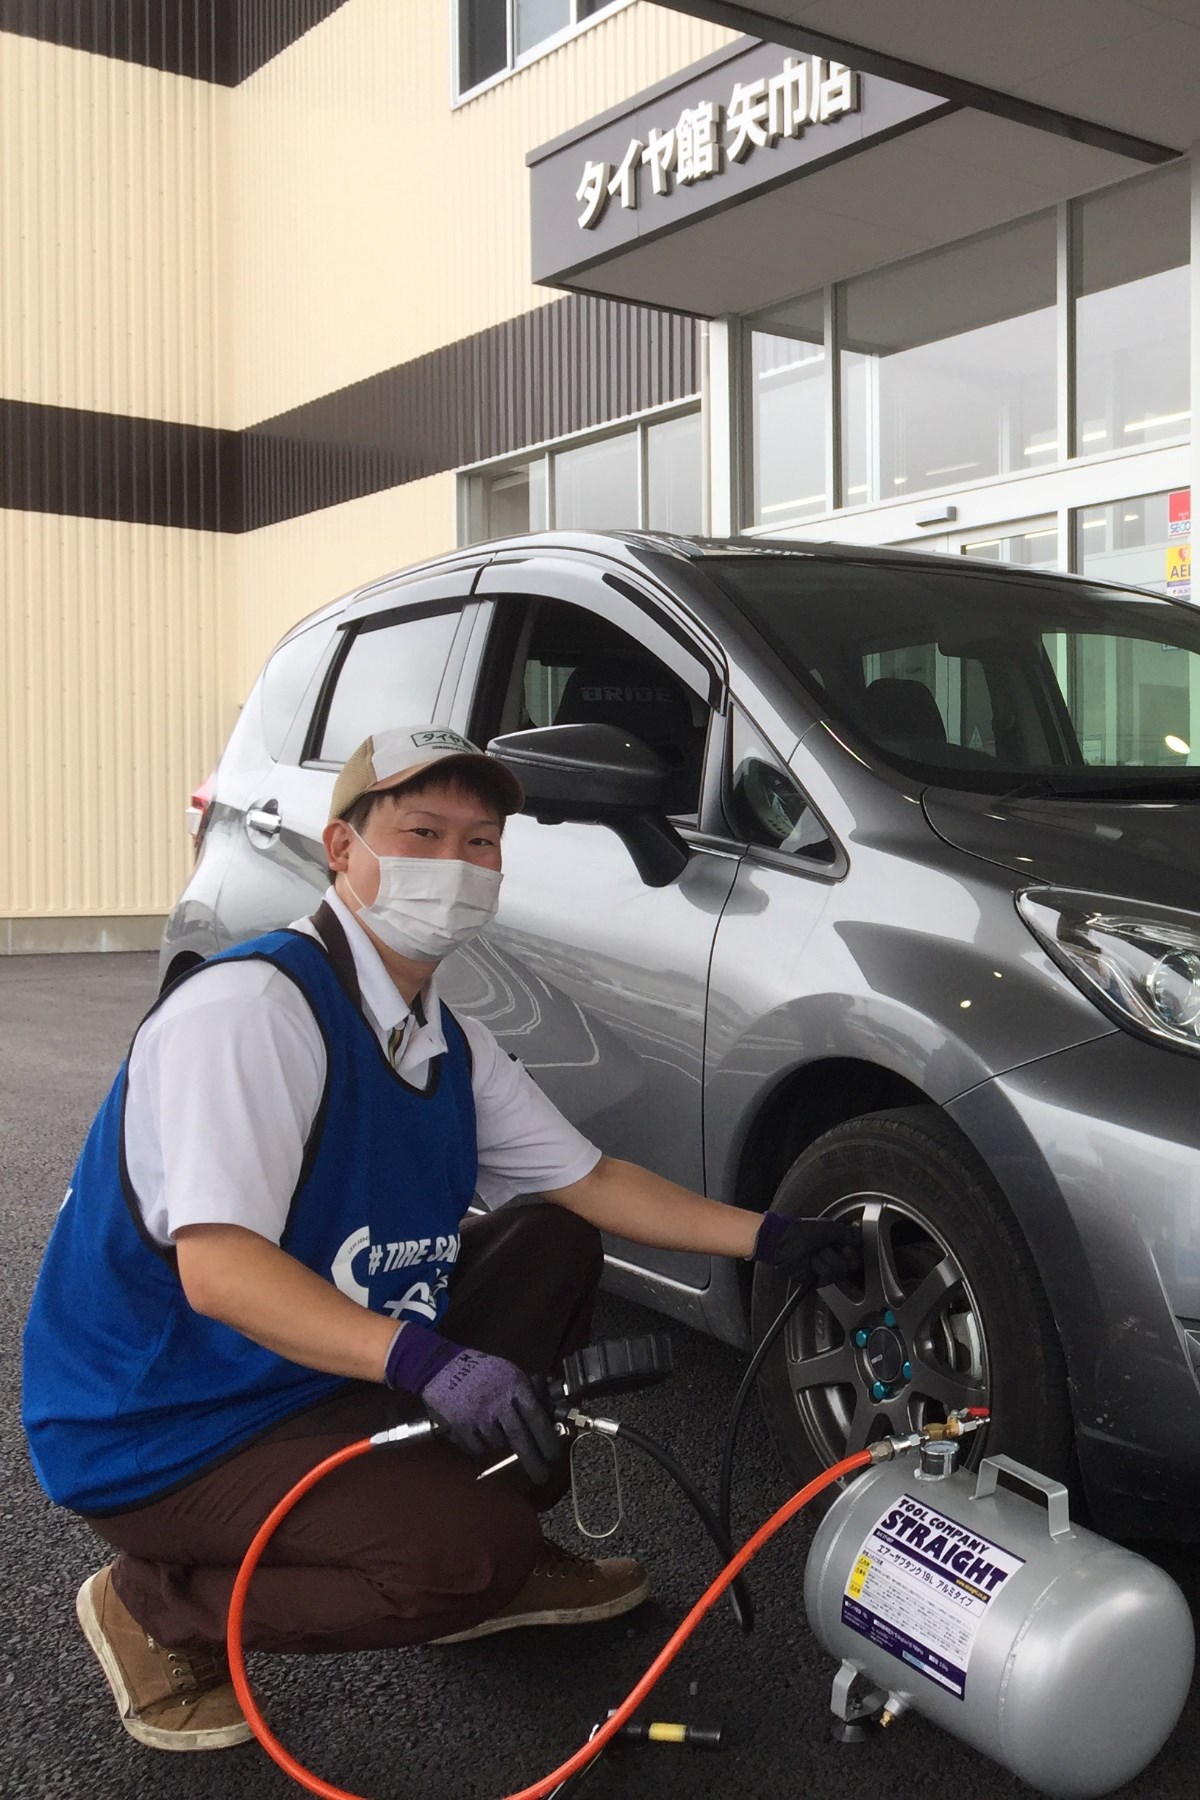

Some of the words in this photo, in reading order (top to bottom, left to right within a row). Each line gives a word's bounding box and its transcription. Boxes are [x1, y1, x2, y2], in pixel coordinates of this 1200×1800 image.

[575, 100, 721, 231] タイヤ館
[726, 54, 858, 163] 矢巾店
[1170, 563, 1191, 579] AE
[880, 1509, 1009, 1593] STRAIGHT
[898, 1498, 926, 1522] TOOL
[929, 1517, 990, 1556] COMPANY
